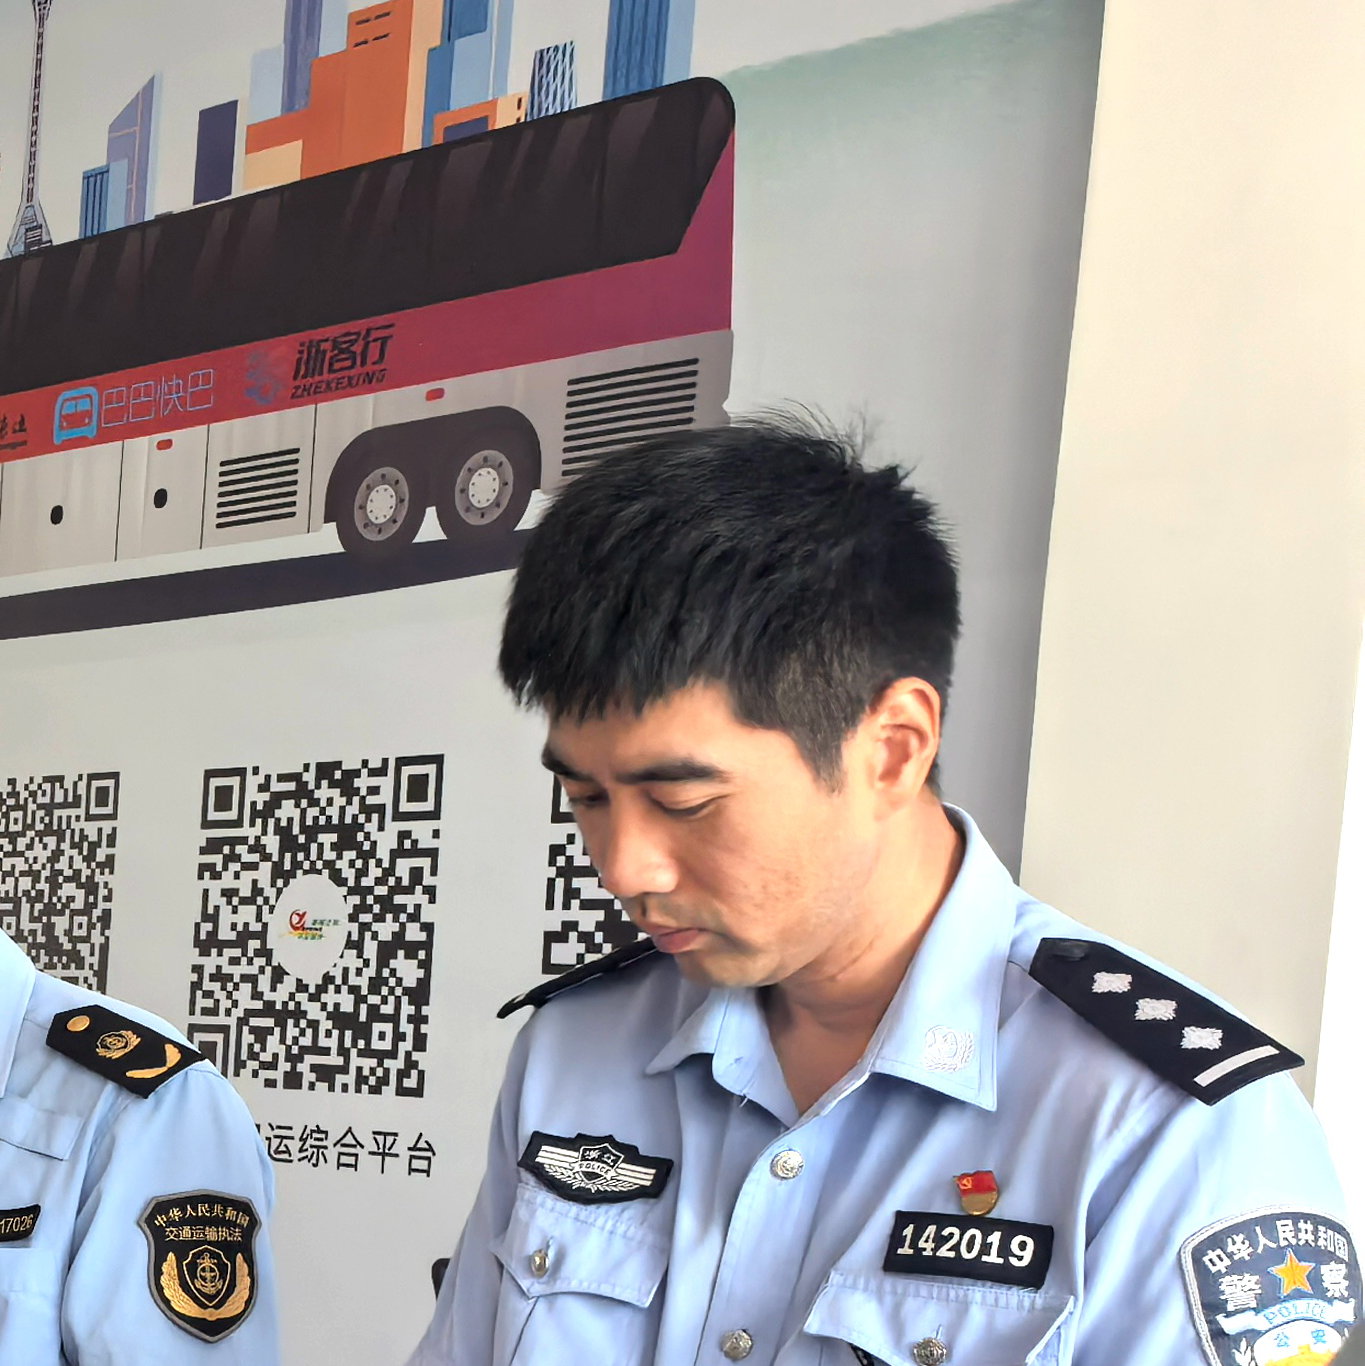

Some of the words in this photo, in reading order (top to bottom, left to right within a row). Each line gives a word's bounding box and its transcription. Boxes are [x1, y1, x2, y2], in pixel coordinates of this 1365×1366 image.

[292, 322, 396, 381] 浙客行
[101, 369, 214, 428] 巴巴快巴
[290, 368, 388, 400] ZHEKEXING
[255, 1122, 436, 1178] 运综合平台
[154, 1202, 250, 1229] 中华人民共和国
[164, 1225, 243, 1242] 交通运输执法
[896, 1223, 1035, 1267] 142019
[1202, 1218, 1349, 1275] 中华人民共和国
